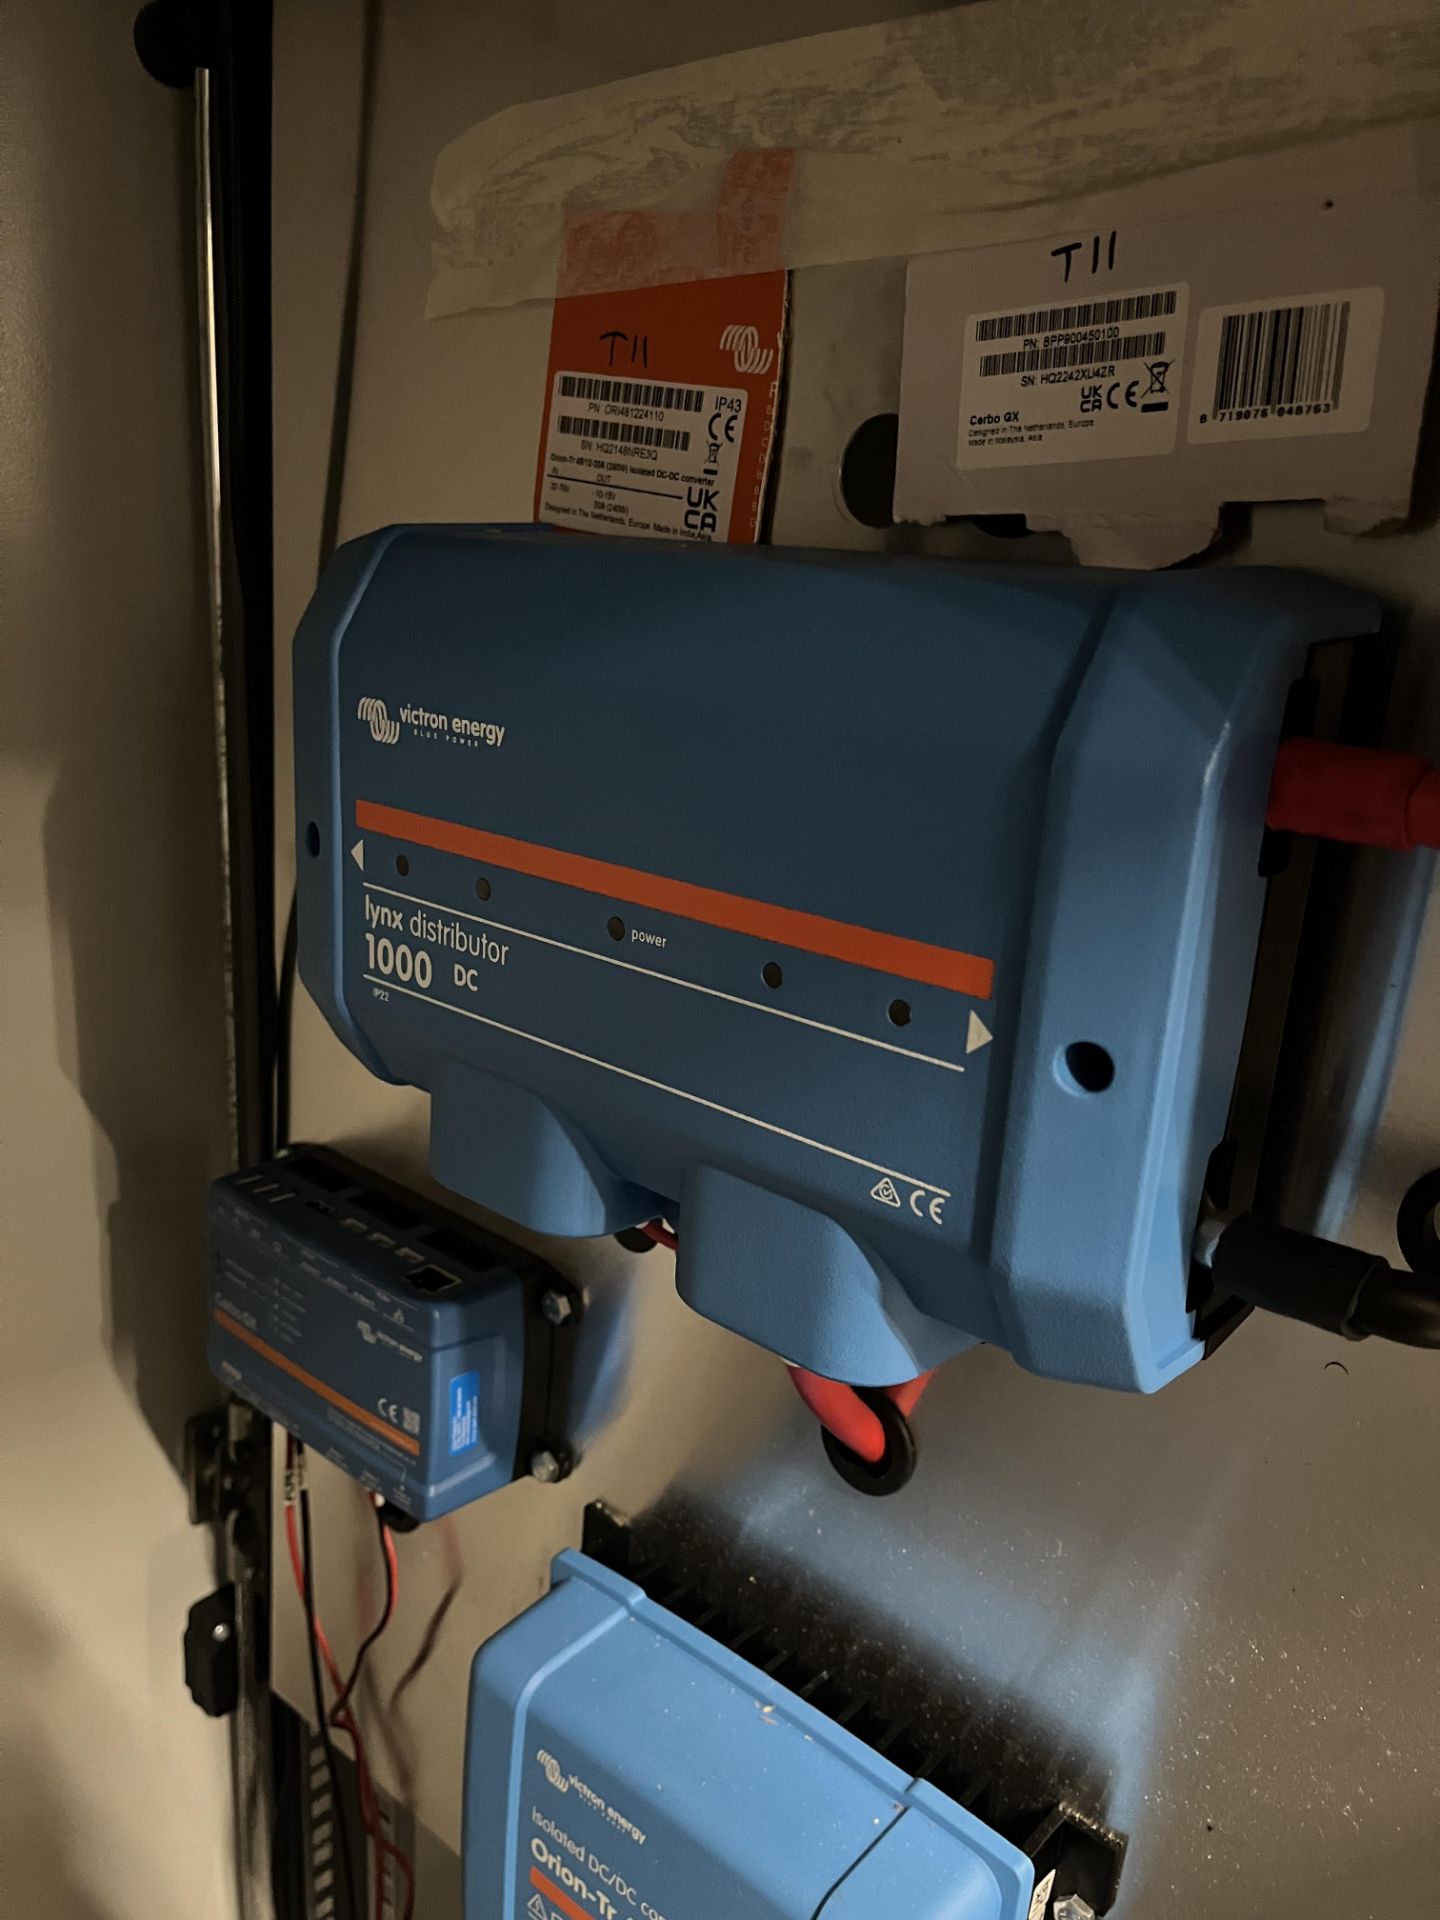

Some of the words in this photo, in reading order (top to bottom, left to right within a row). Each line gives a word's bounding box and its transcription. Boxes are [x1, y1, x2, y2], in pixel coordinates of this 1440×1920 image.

[1043, 327, 1119, 347] BPP900450100
[1040, 365, 1115, 384] HQ2242XU4ZR
[715, 395, 742, 413] IP43
[1200, 414, 1207, 424] 8
[1220, 408, 1268, 422] 719076
[1277, 403, 1330, 417] 048763
[969, 413, 1000, 425] Cerbo
[1004, 411, 1020, 422] GX
[656, 470, 680, 481] DC-DC
[681, 475, 715, 486] converter
[399, 703, 448, 731] victron
[451, 717, 505, 747] energy
[365, 893, 403, 931] lynx
[410, 909, 509, 966] distributor
[631, 929, 668, 948] power
[365, 932, 433, 989] 1000
[453, 963, 478, 992] DC
[568, 1774, 605, 1810] victron
[607, 1806, 647, 1845] energy
[531, 1837, 618, 1920] Orion-Tr
[588, 1853, 637, 1906] DC/DC
